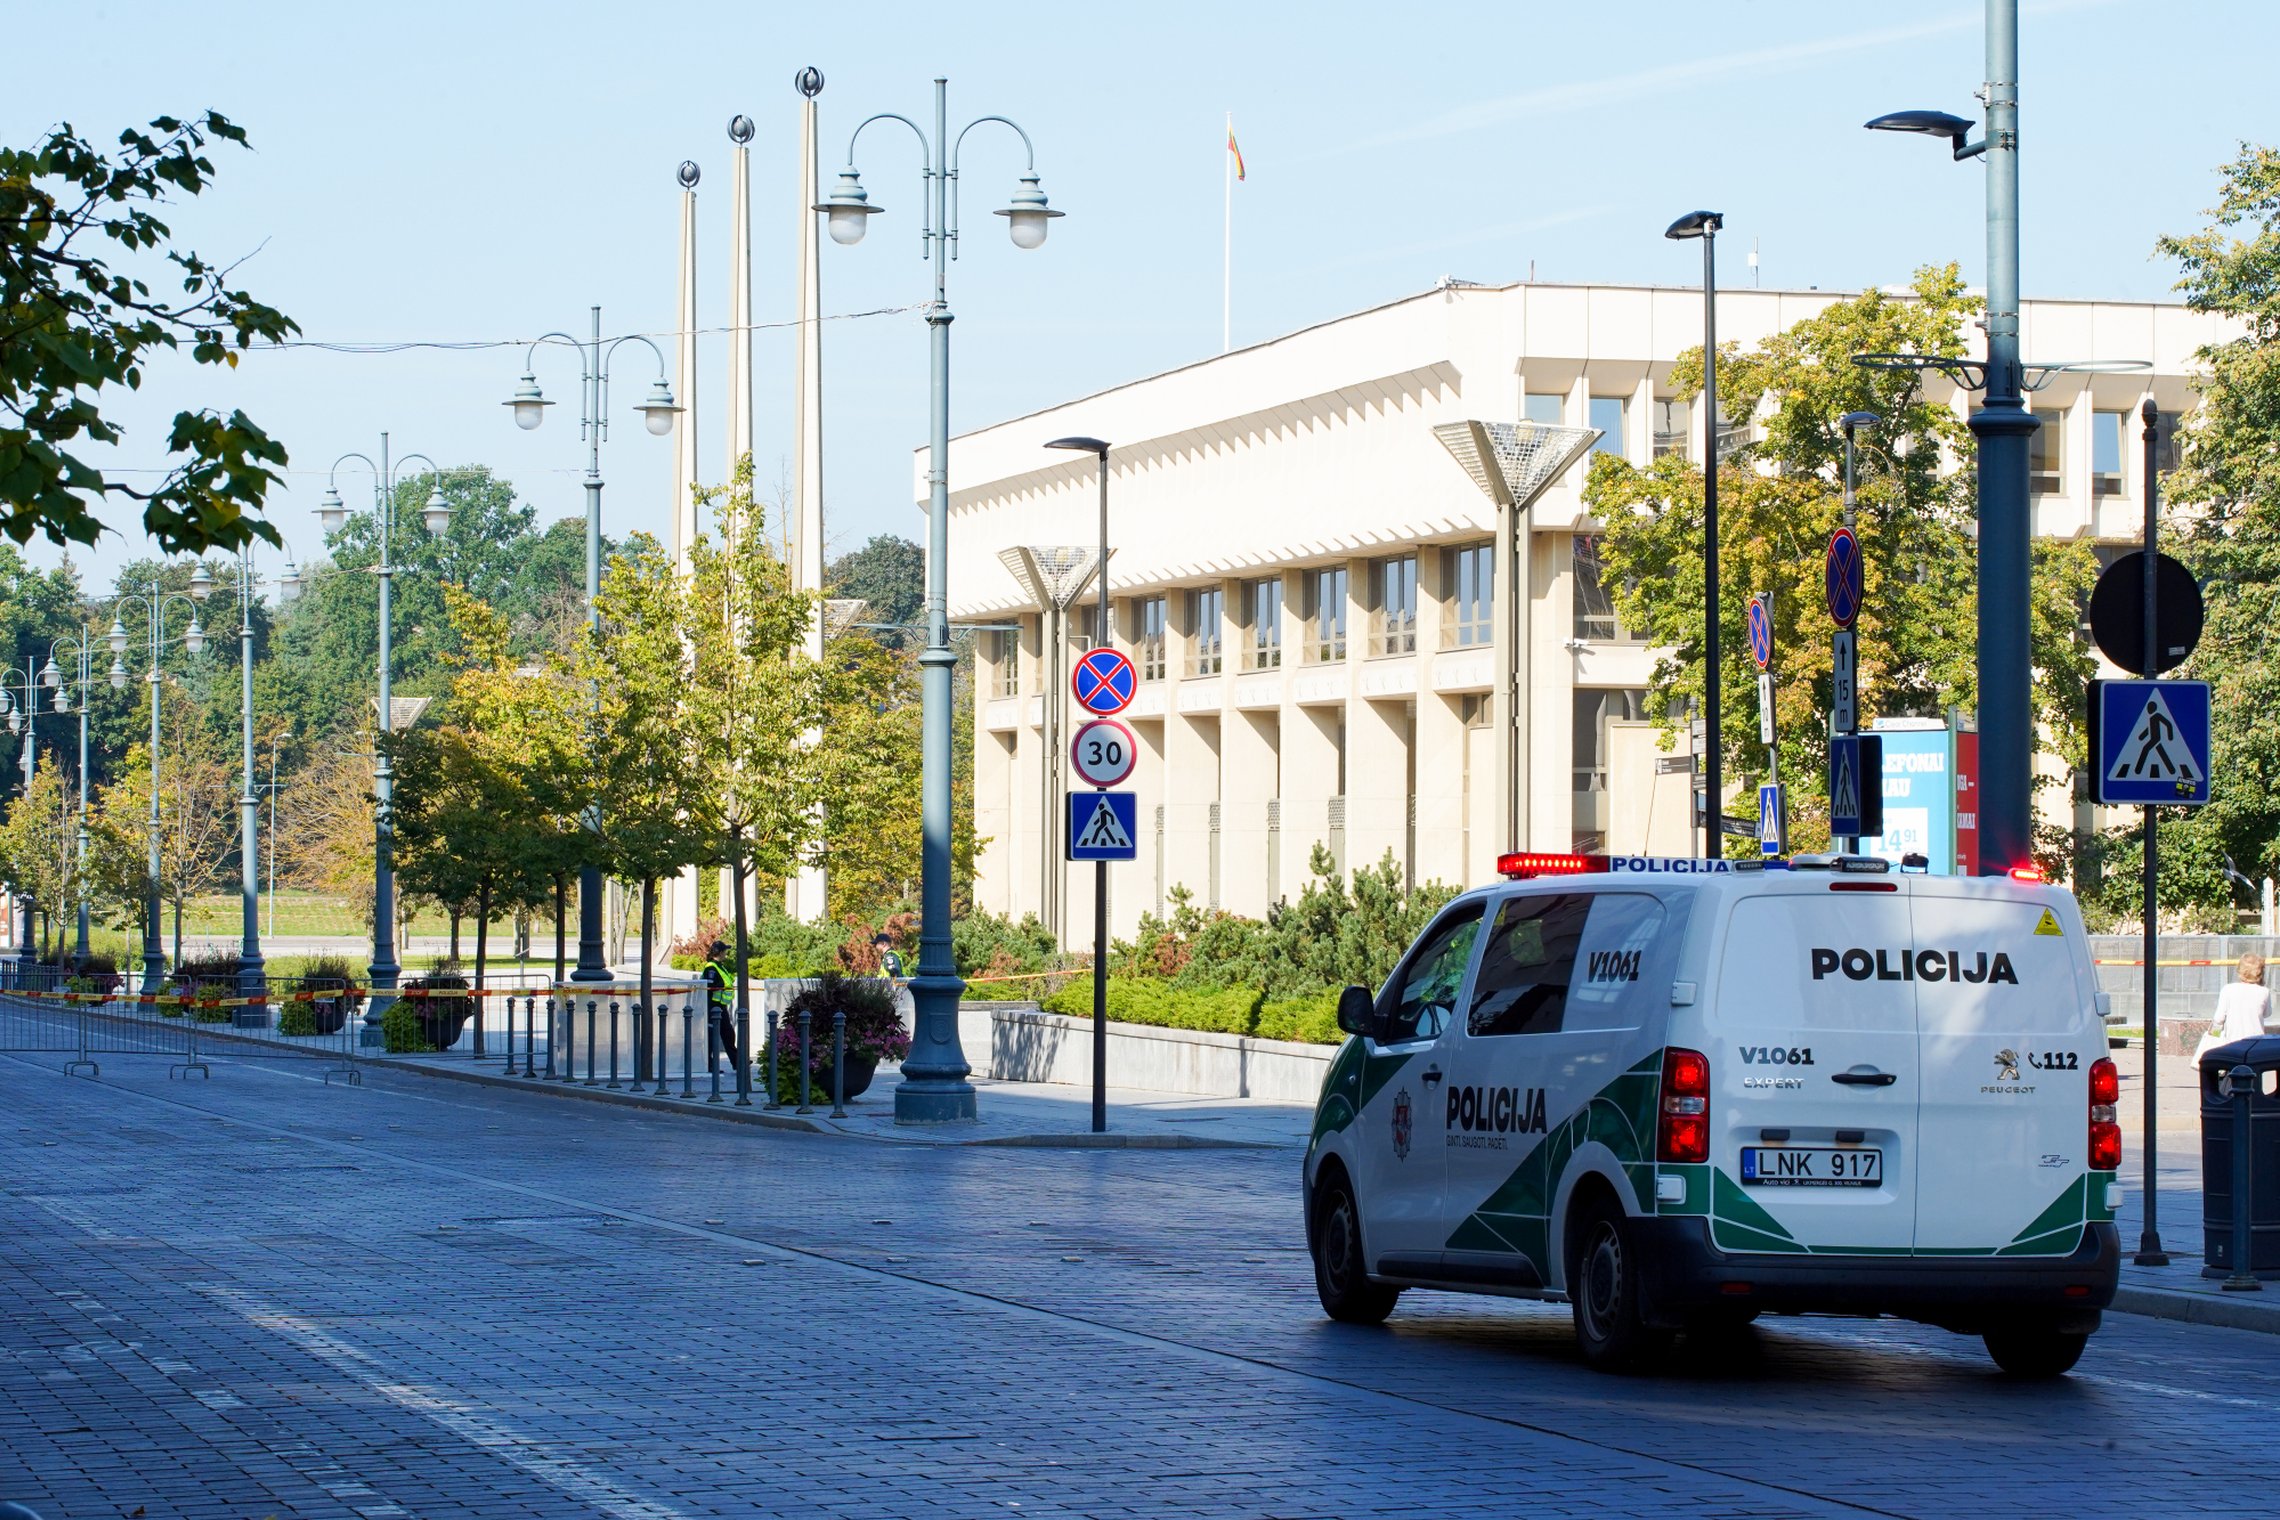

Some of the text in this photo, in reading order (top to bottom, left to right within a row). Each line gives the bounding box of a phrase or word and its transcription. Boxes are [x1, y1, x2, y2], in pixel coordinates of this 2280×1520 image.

[1838, 680, 1849, 701] 15
[1840, 708, 1848, 723] m
[1088, 741, 1122, 766] 30
[1882, 752, 1945, 773] EFONAI
[1612, 857, 1729, 873] POLICIJA
[1588, 950, 1642, 983] V1061
[1811, 948, 2019, 985] POLICIJA
[1738, 1047, 1814, 1065] V1061
[2044, 1052, 2078, 1070] 112
[1744, 1077, 1804, 1089] EXPERT
[1981, 1086, 2036, 1094] PEUGEOT
[1446, 1086, 1547, 1134] POLICIJA
[1744, 1166, 1755, 1174] LT
[1759, 1152, 1876, 1177] LNK 917
